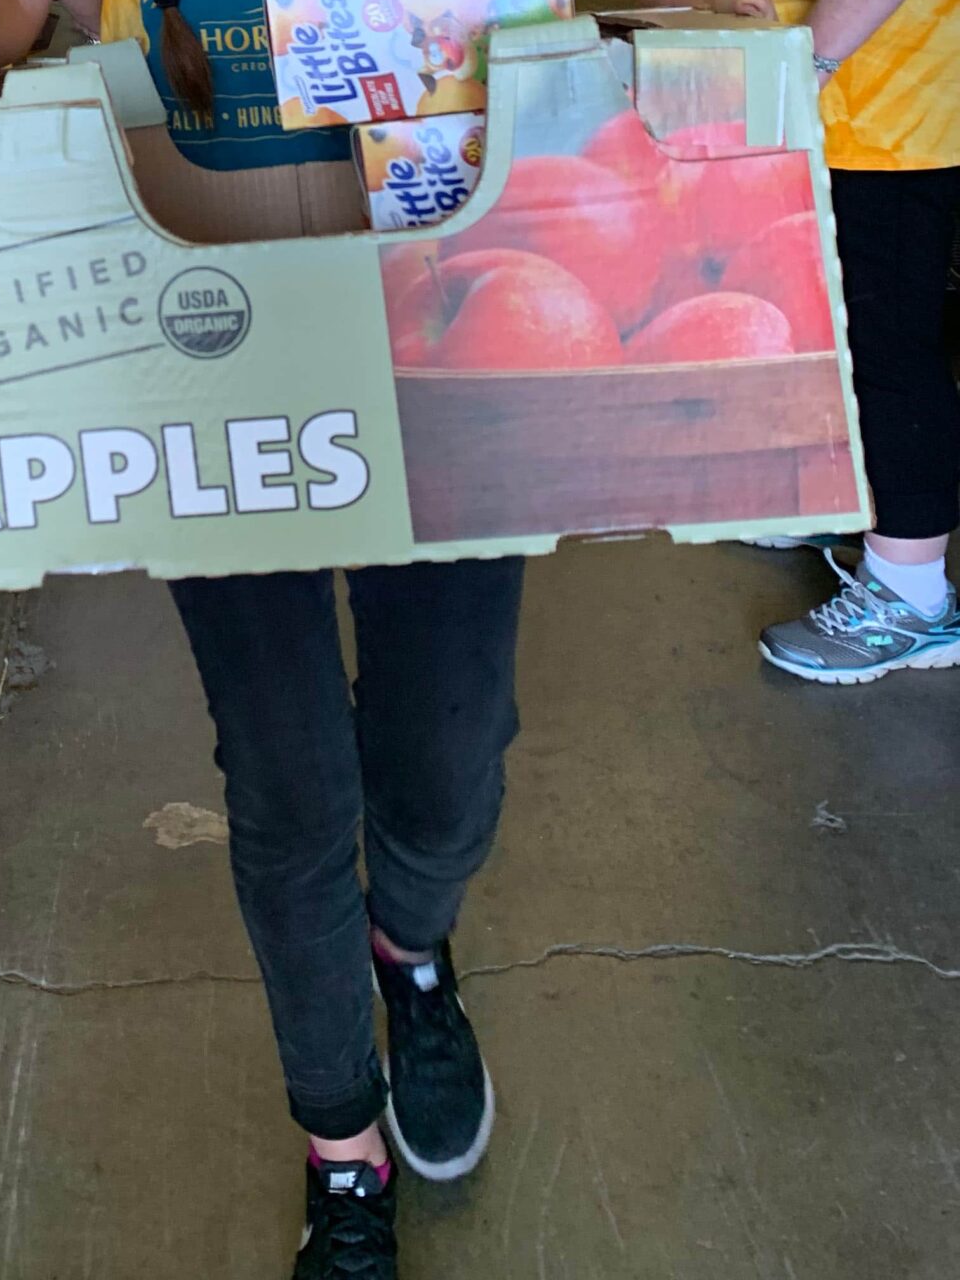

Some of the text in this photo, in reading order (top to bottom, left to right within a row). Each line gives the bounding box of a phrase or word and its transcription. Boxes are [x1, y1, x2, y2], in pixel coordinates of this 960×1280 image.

[200, 26, 269, 52] HOR
[292, 24, 358, 106] Little
[416, 126, 470, 214] Bites
[178, 290, 229, 310] USDA
[172, 313, 240, 336] ORGANIC
